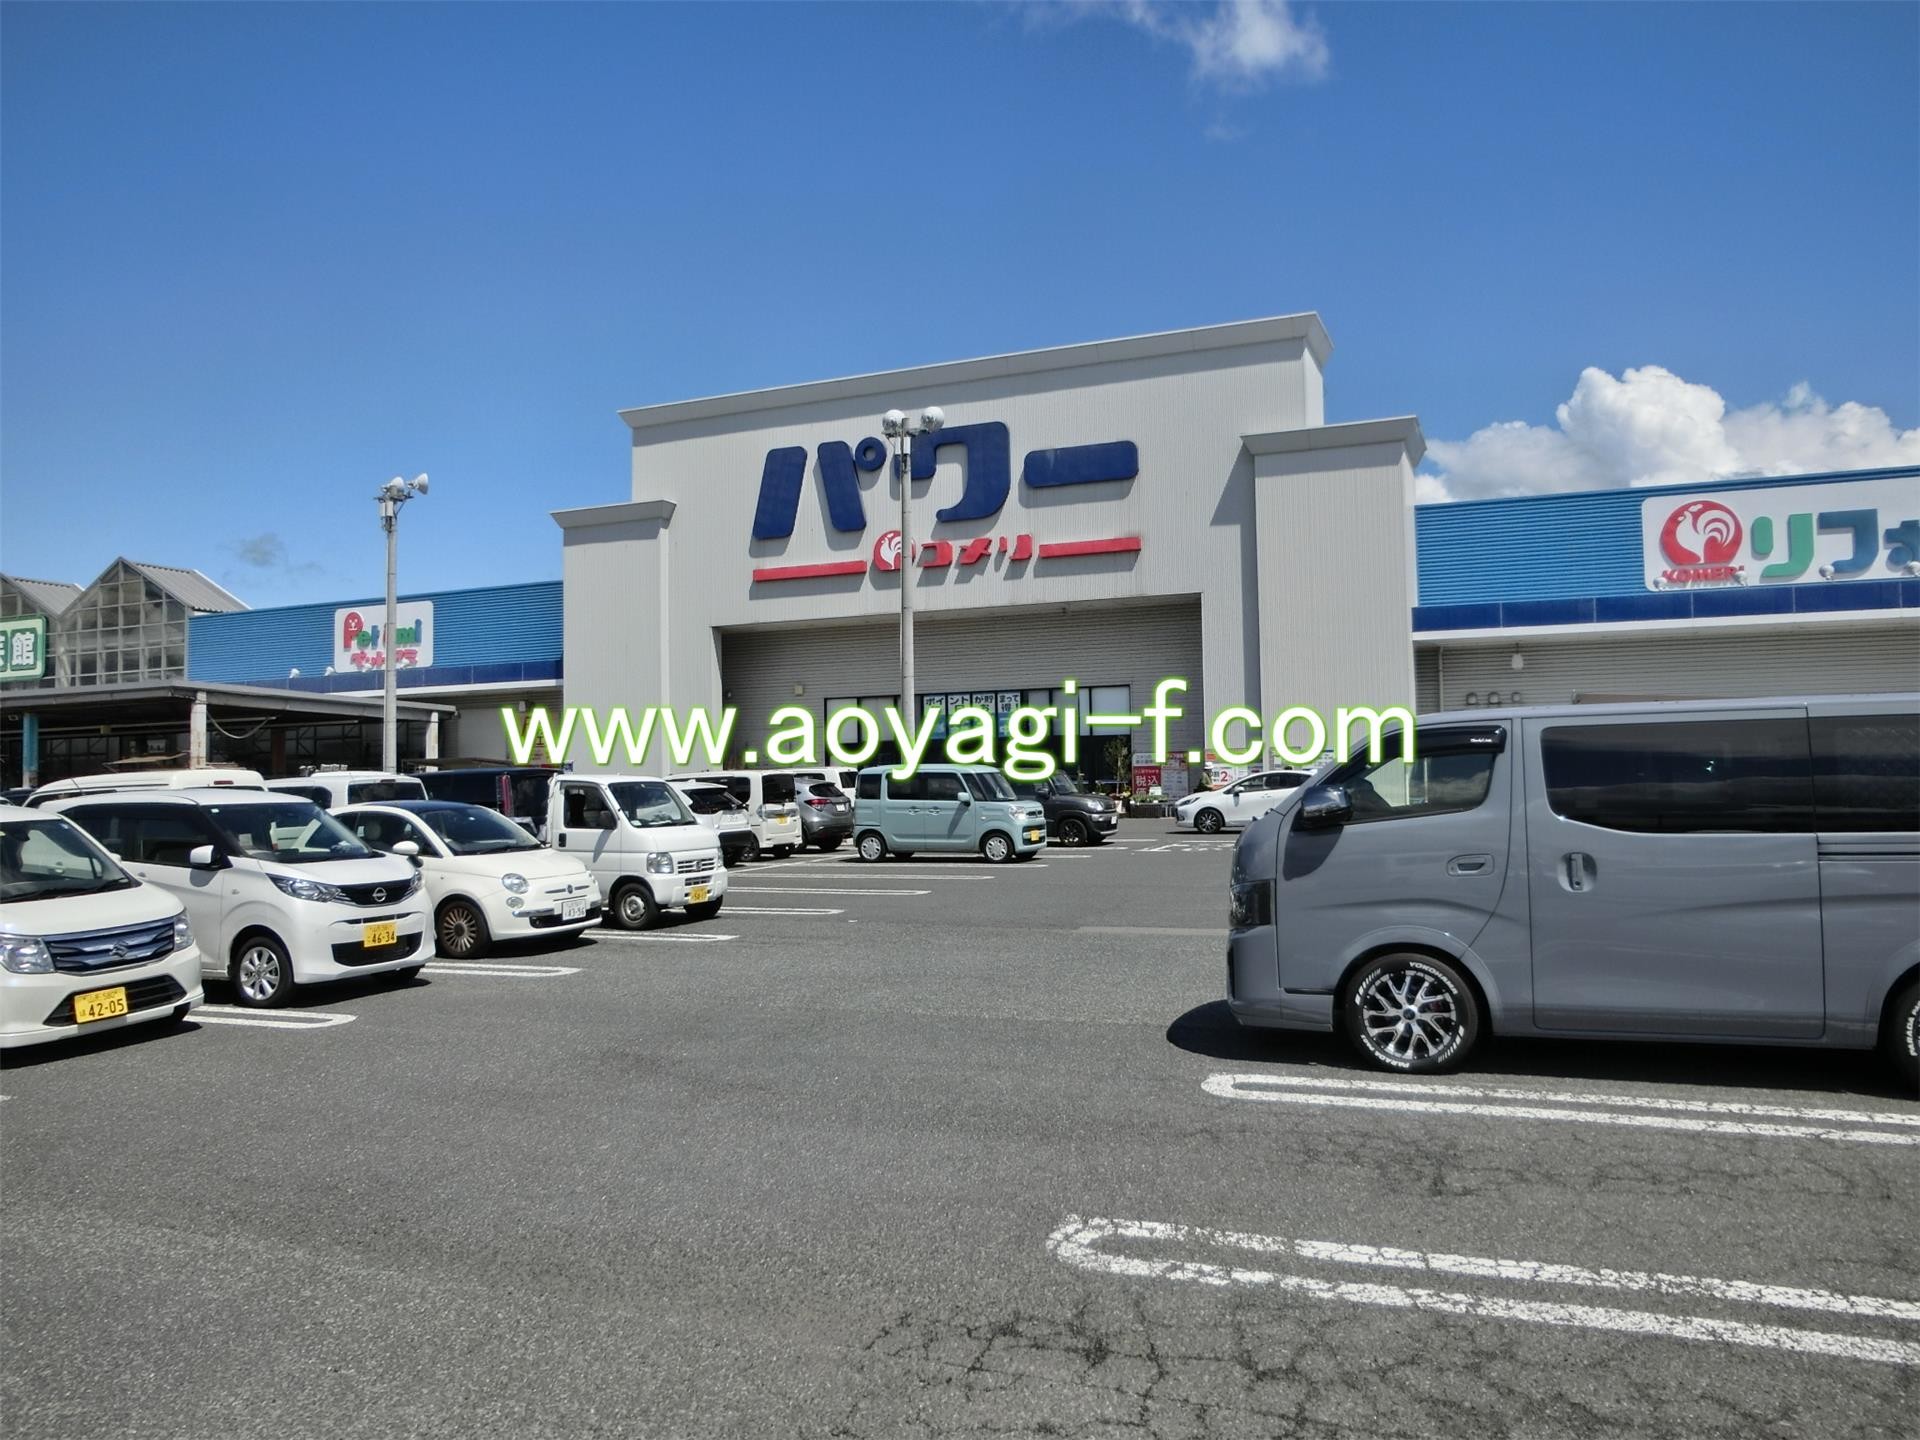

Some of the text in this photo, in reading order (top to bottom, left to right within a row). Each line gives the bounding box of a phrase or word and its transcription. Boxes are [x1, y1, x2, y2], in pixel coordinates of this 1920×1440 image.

[752, 420, 1139, 540] パワー
[921, 533, 1033, 568] コメリ
[0, 630, 35, 666] 館
[372, 930, 395, 944] 46-34
[1409, 961, 1459, 995] YOKOHAMA
[88, 998, 125, 1018] 42-05
